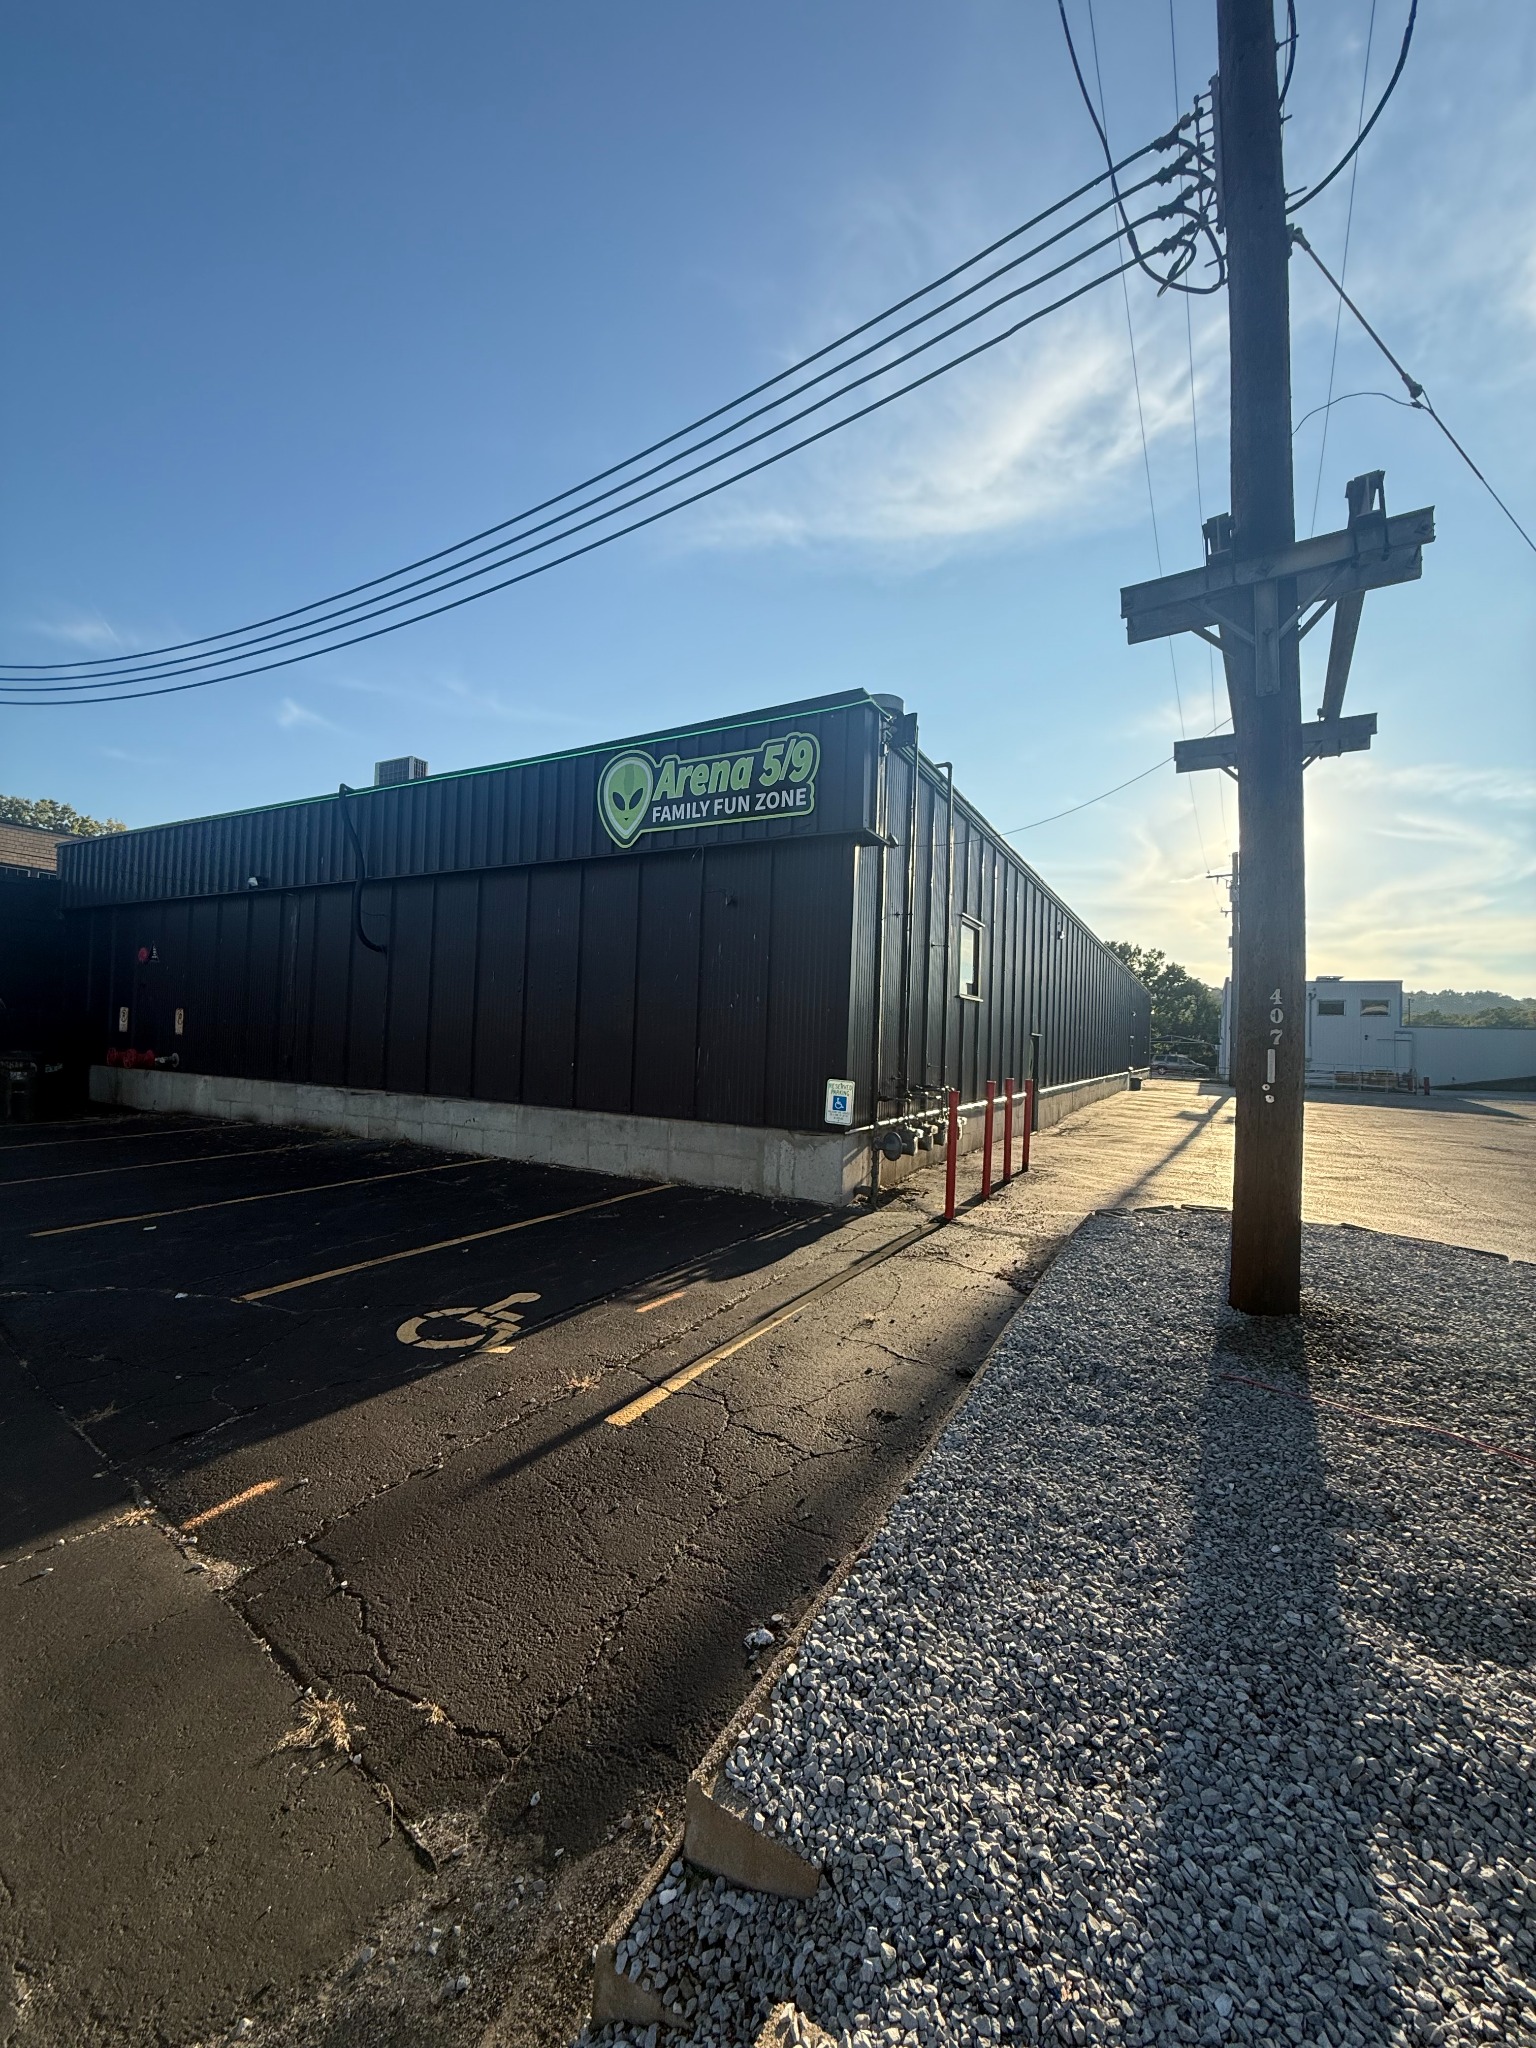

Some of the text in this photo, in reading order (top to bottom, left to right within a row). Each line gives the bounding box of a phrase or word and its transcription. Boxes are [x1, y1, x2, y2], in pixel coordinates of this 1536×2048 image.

[652, 738, 814, 801] Arena 5/9
[652, 788, 807, 823] FAMILY FUN ZONE
[828, 1082, 853, 1091] RESERVED
[831, 1089, 850, 1097] PARKING
